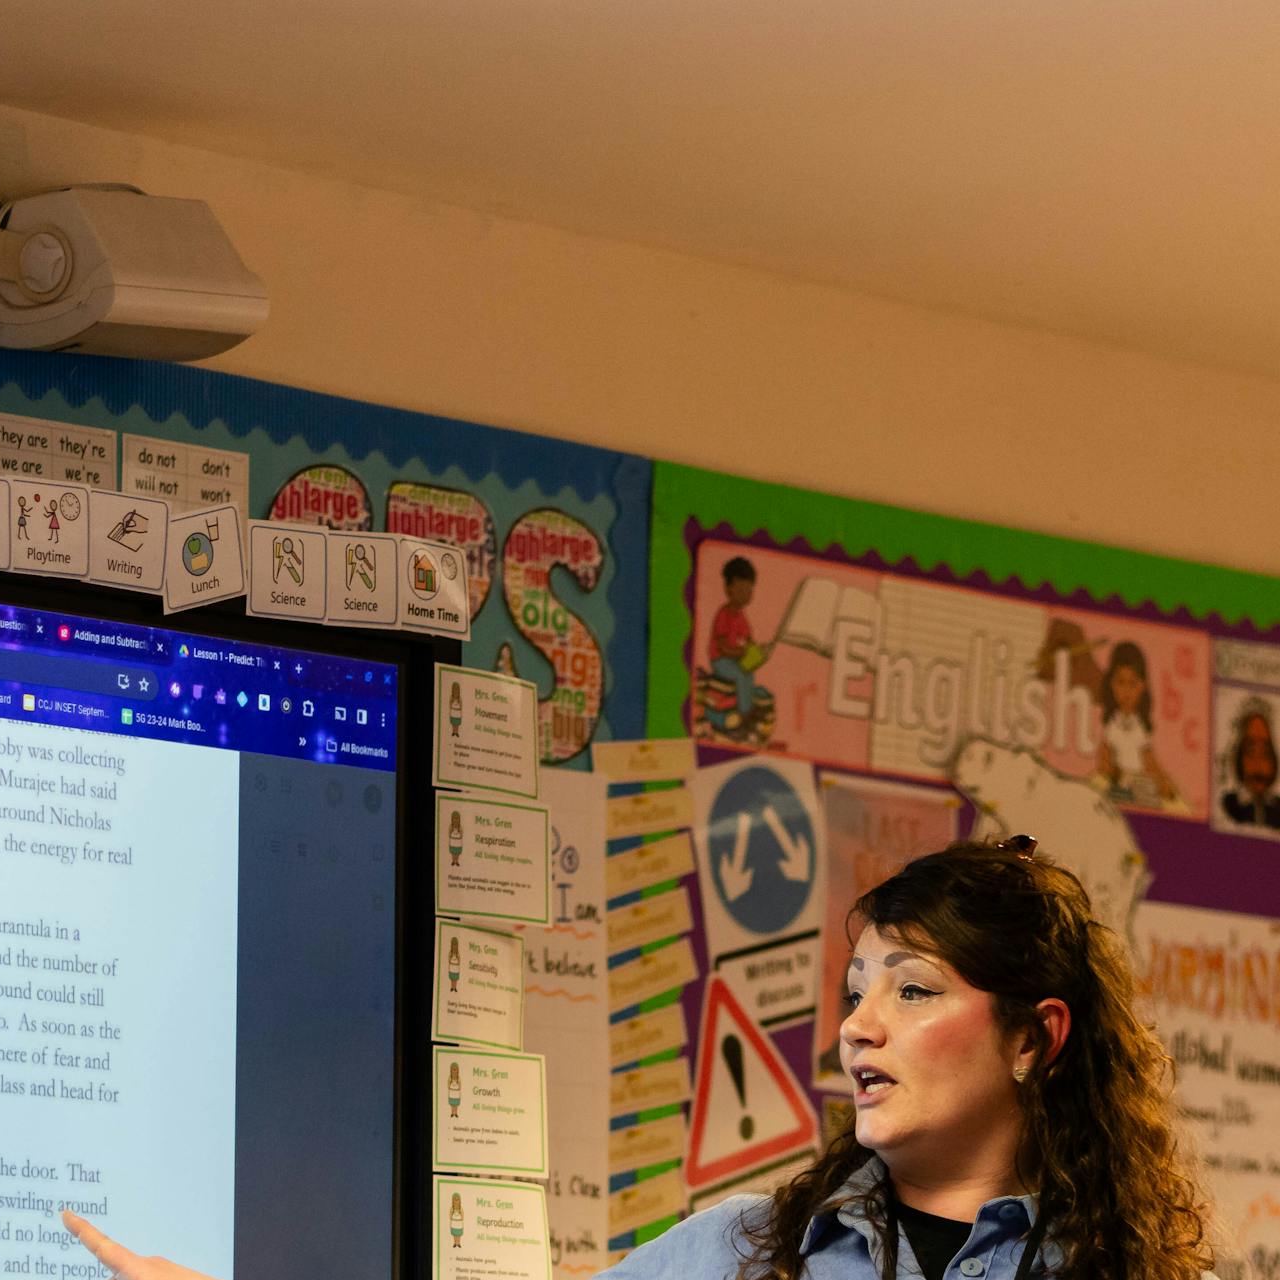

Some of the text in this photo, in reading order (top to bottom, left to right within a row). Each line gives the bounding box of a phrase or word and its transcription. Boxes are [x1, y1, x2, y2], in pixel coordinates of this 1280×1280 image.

[27, 435, 48, 448] are
[60, 438, 105, 459] they're
[2, 458, 43, 474] we are
[139, 449, 176, 468] do not
[66, 467, 100, 484] we're
[202, 460, 230, 477] don't
[135, 477, 178, 495] will not
[201, 488, 231, 502] won't
[27, 548, 71, 565] Playtime
[107, 559, 142, 578] Writing
[191, 576, 220, 593] Lunch
[271, 592, 306, 606] Science
[344, 598, 378, 612] Science
[408, 604, 459, 622] Home Time
[75, 630, 115, 645] Adding and
[194, 648, 255, 667] Lesson 1 Predict:
[828, 616, 1097, 768] English
[38, 698, 75, 713] CCJ INSET
[136, 712, 185, 730] 5G 23-24 Mark
[475, 708, 507, 722] Movement
[341, 742, 388, 758] All Bookmarks
[60, 773, 86, 795] had
[90, 777, 117, 799] said
[475, 835, 515, 848] Respiration
[55, 920, 69, 939] in
[72, 928, 80, 941] a
[469, 961, 498, 977] Sensitivity
[545, 952, 596, 979] believe
[473, 1087, 500, 1098] Growth
[21, 1157, 59, 1178] door.
[66, 1161, 101, 1181] That
[476, 1198, 493, 1208] Mrs.
[477, 1217, 524, 1229] Reproduction
